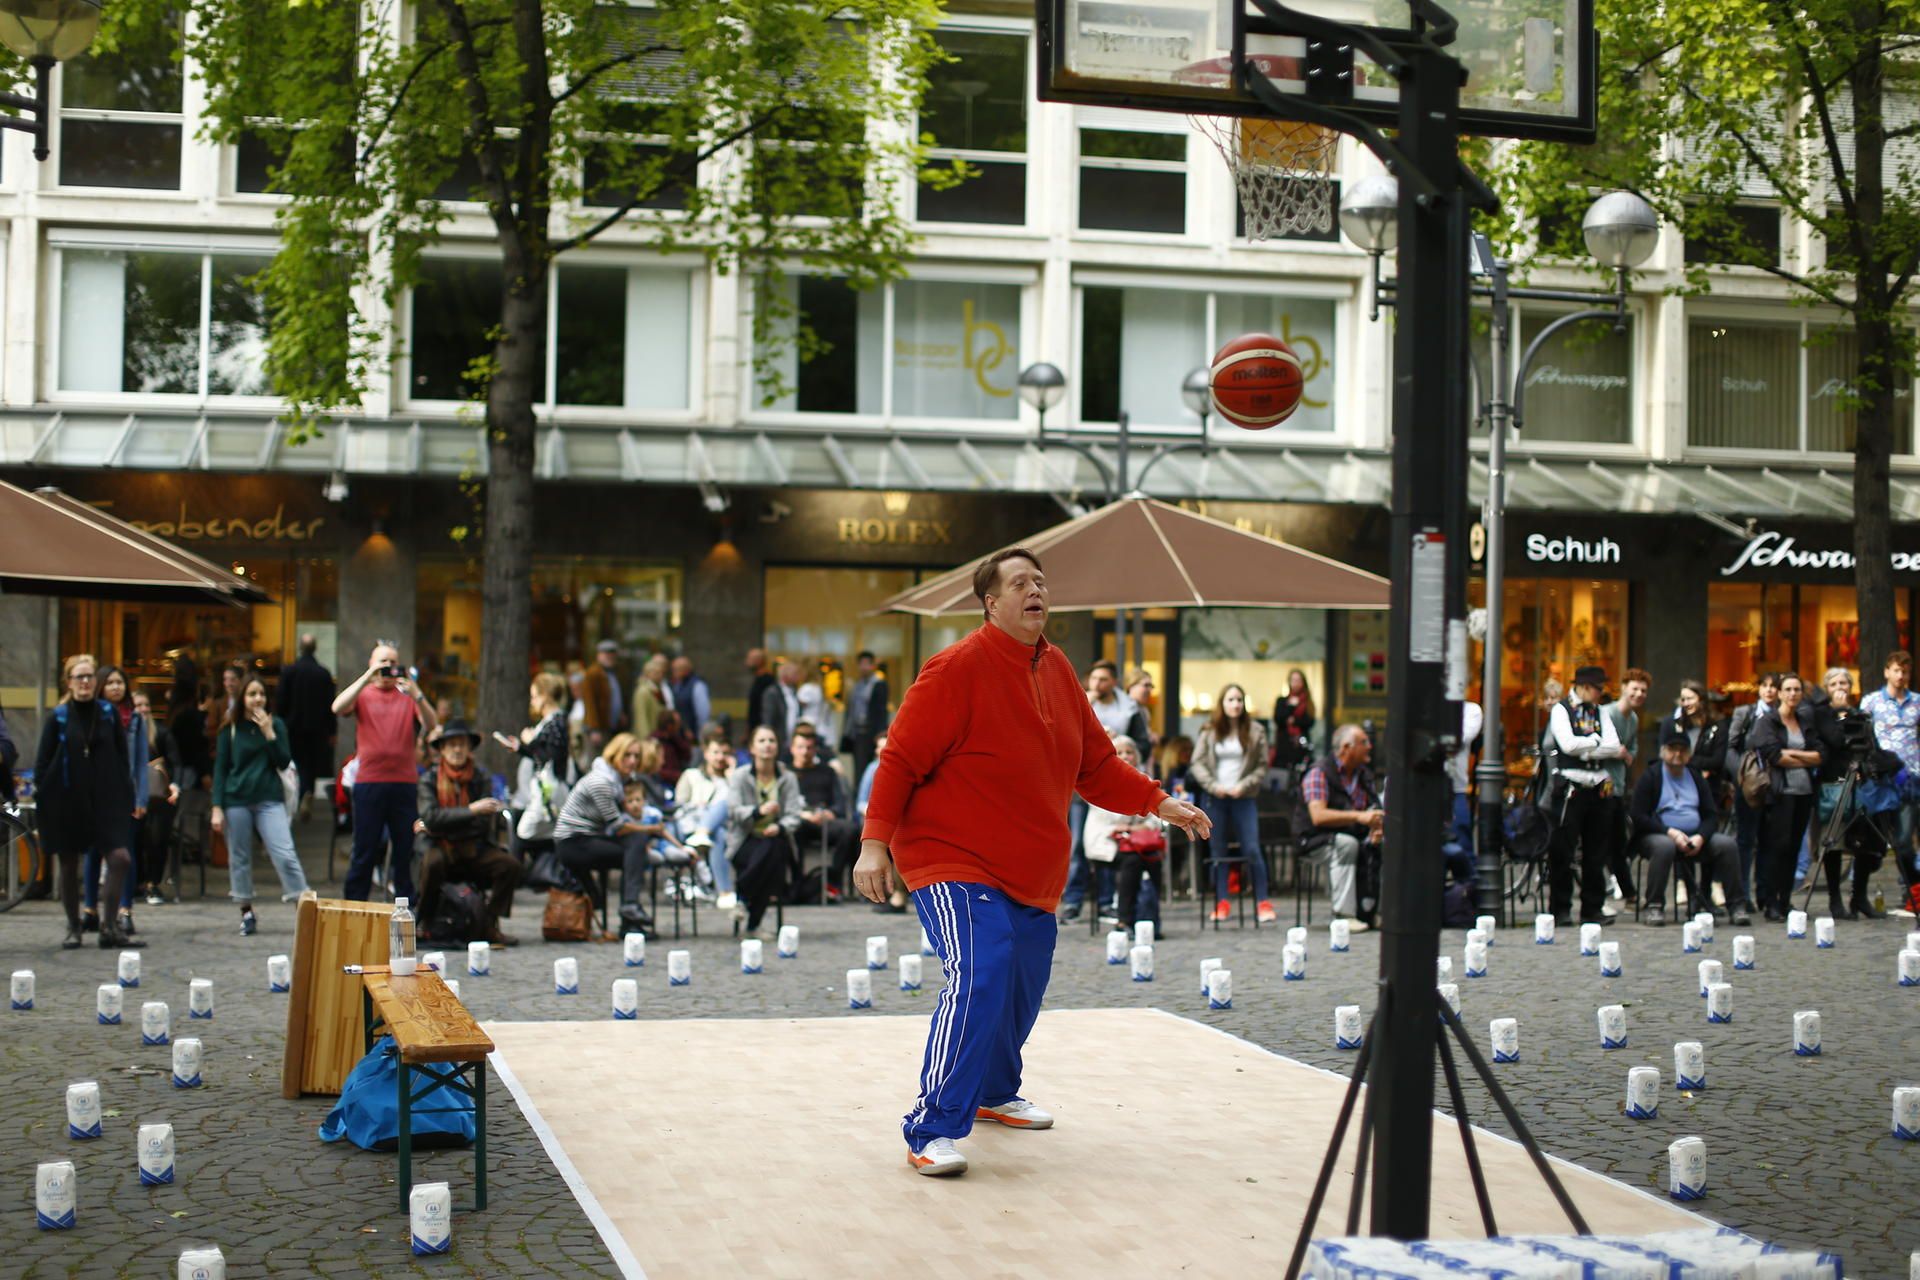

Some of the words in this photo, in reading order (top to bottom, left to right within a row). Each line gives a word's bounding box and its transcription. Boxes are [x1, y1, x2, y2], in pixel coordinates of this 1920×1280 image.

[1231, 366, 1288, 382] molten
[1722, 376, 1768, 393] Schuh
[838, 517, 951, 544] ROLEX
[1526, 533, 1621, 563] Schuh
